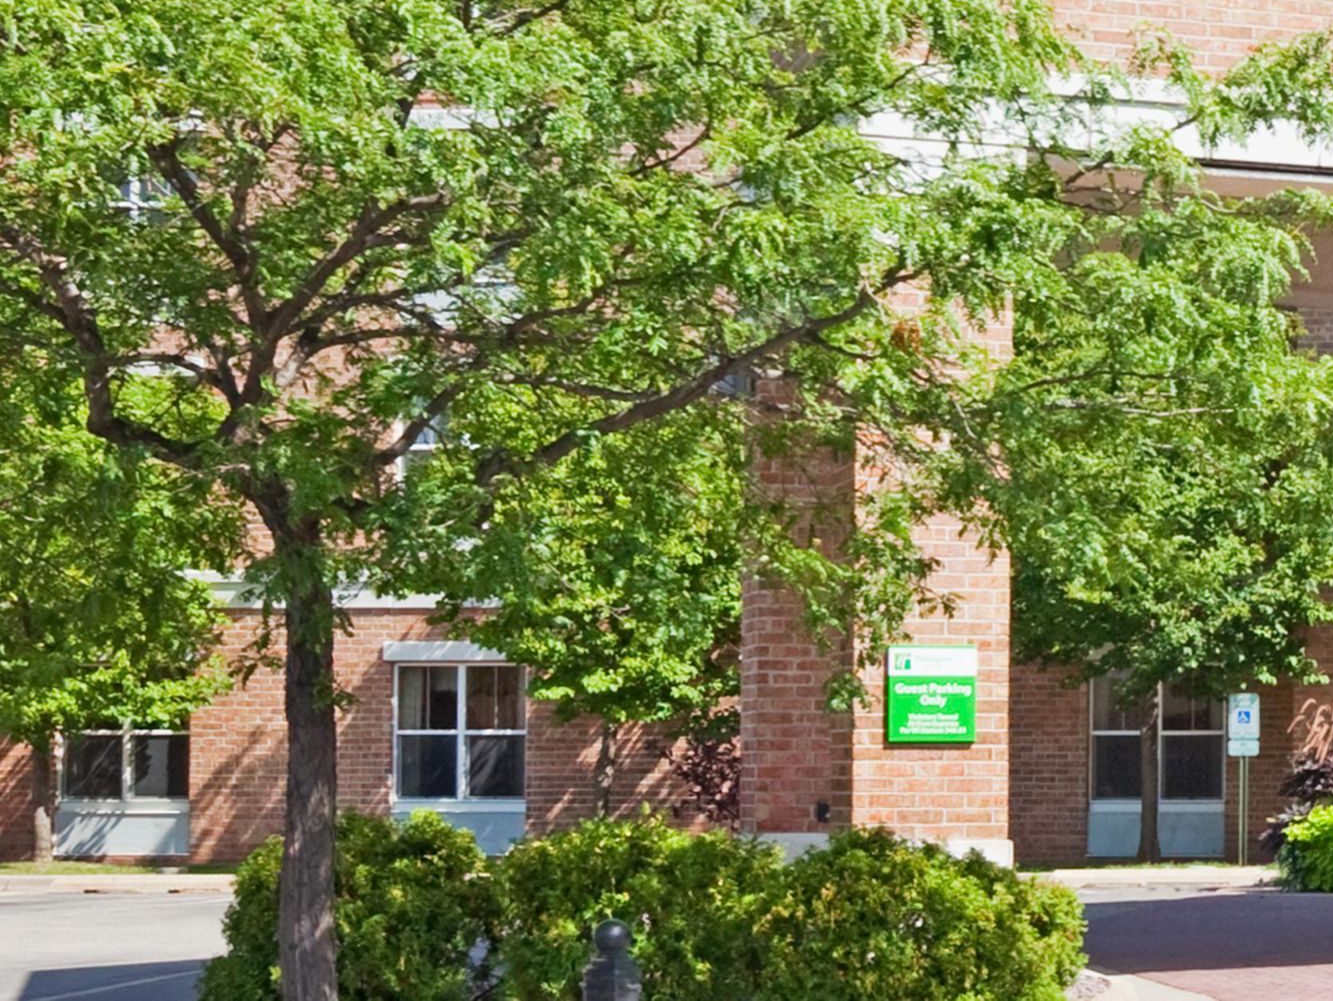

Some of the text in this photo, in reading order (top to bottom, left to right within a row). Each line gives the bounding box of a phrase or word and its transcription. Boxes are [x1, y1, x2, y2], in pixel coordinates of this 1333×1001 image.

[894, 682, 972, 697] Guest Parking
[919, 694, 948, 708] Only
